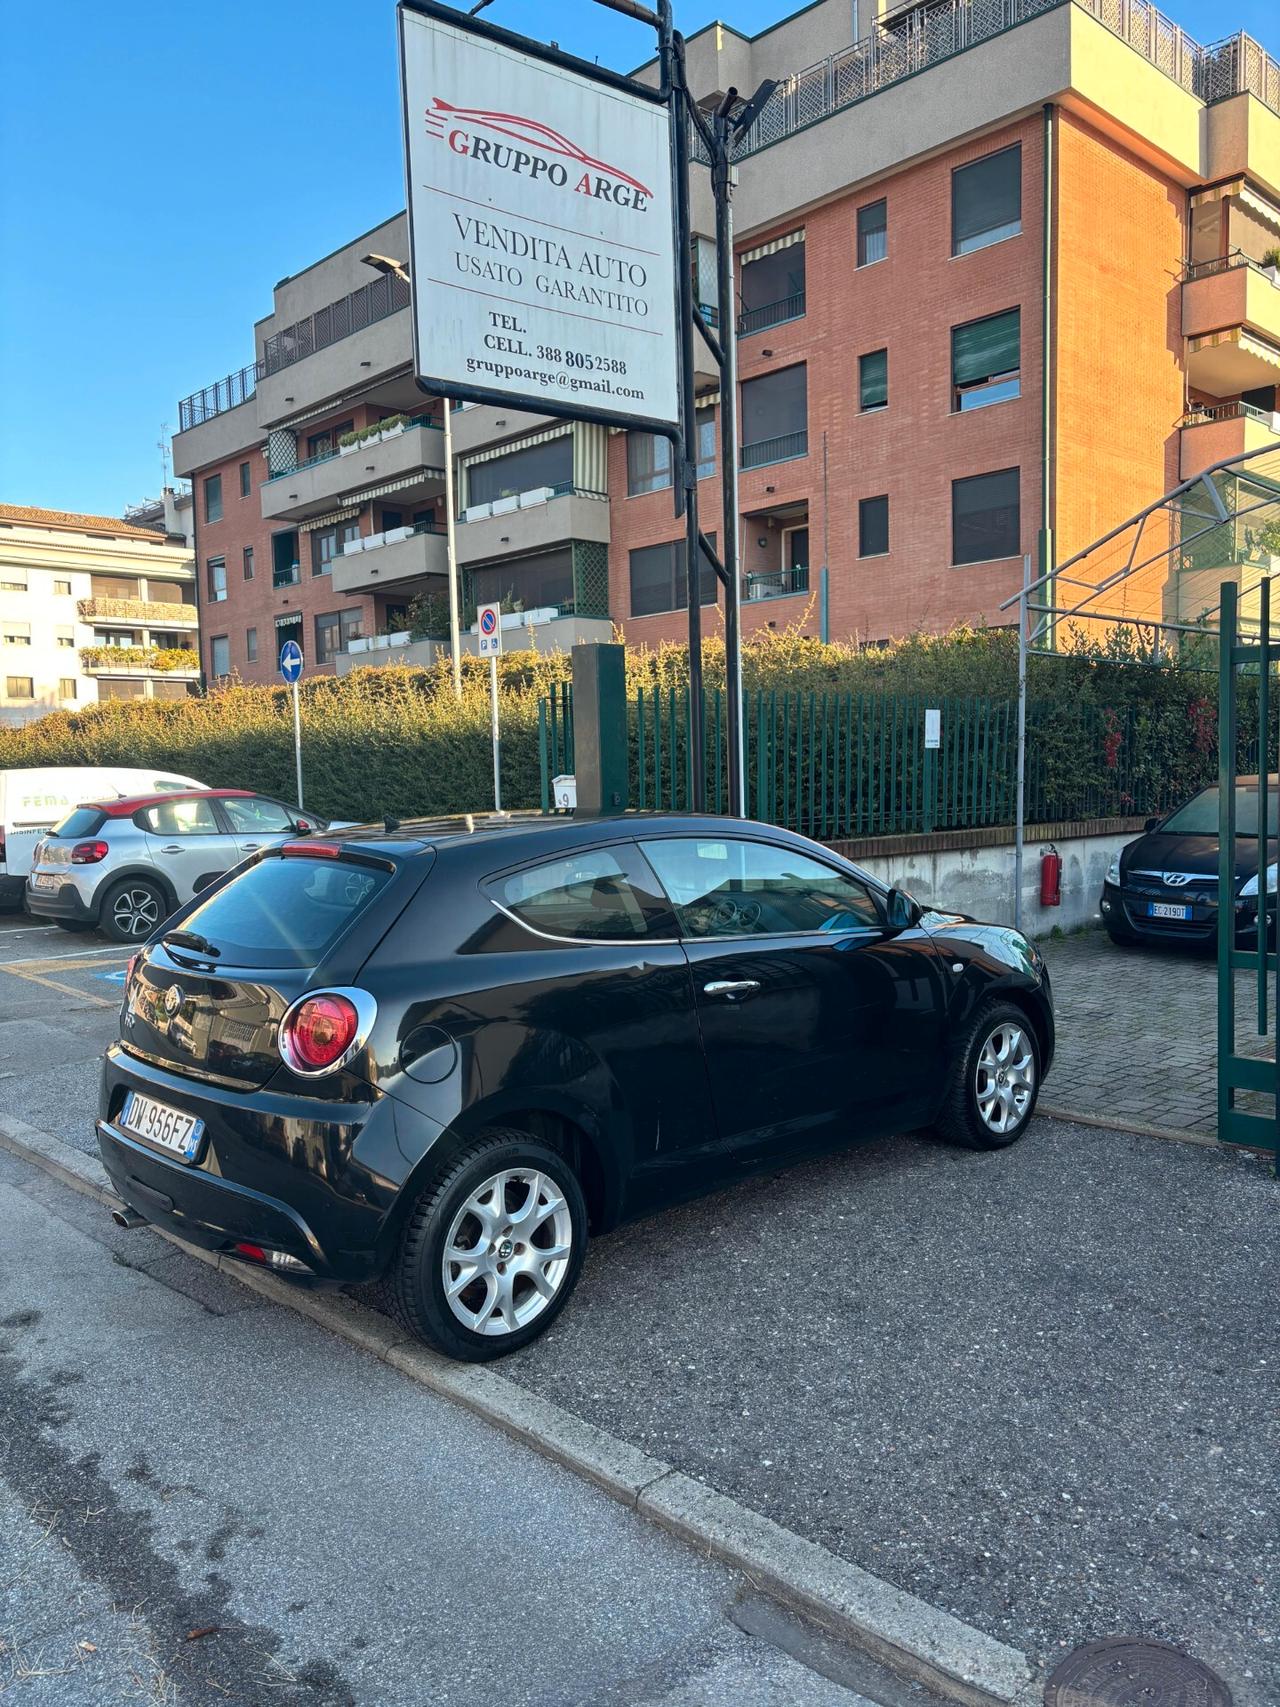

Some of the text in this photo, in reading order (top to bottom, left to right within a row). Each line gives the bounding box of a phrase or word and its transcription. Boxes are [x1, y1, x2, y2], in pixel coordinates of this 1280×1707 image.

[449, 130, 648, 212] GRUPPO ARGE
[452, 213, 647, 288] VENDITA AUTO
[455, 252, 649, 317] USATO GARANTITO
[489, 312, 527, 334] TEL.
[484, 334, 627, 376] CELL. 388 8052588
[467, 358, 645, 400] gruppoarge@gmail.com
[563, 793, 569, 807] 9
